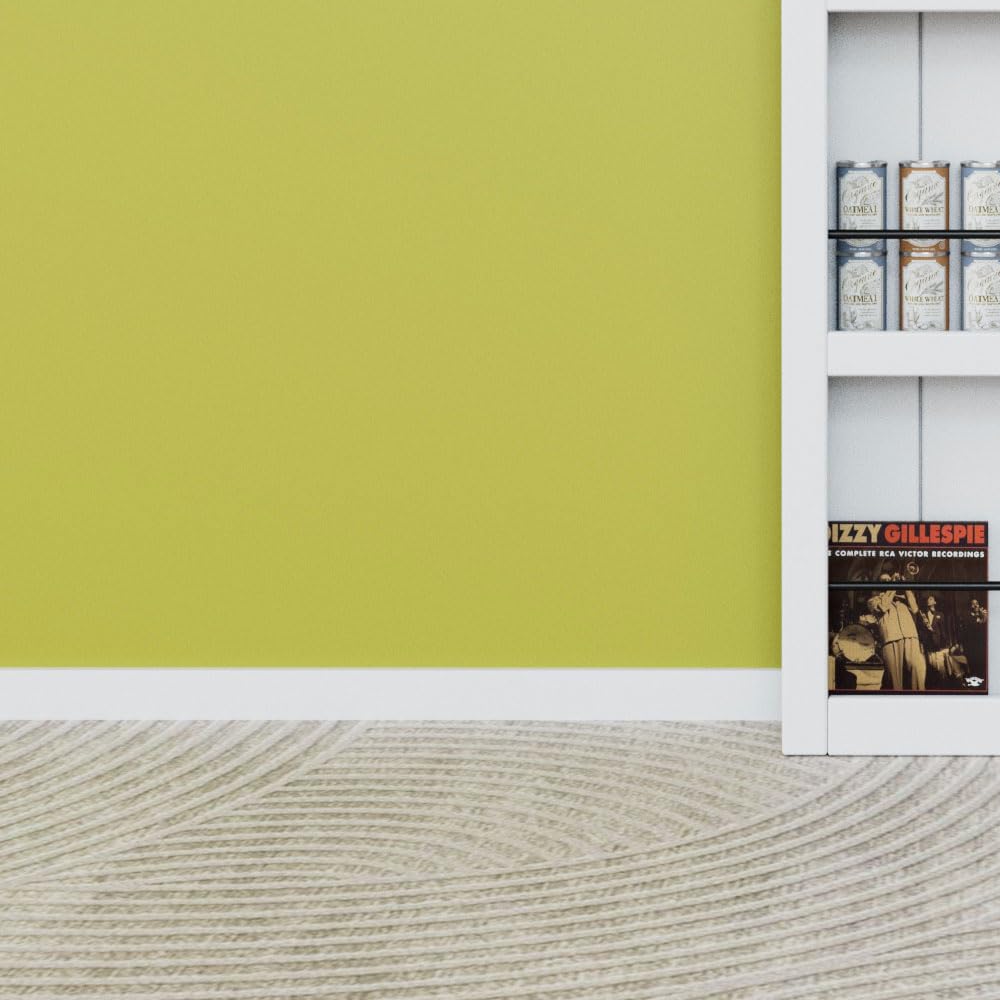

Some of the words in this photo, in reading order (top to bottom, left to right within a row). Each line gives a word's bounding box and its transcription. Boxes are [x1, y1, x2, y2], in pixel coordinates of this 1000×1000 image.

[828, 523, 882, 543] IZZY
[884, 524, 985, 544] GILLESPIE
[880, 550, 895, 558] RCA
[899, 550, 928, 558] VICTOR
